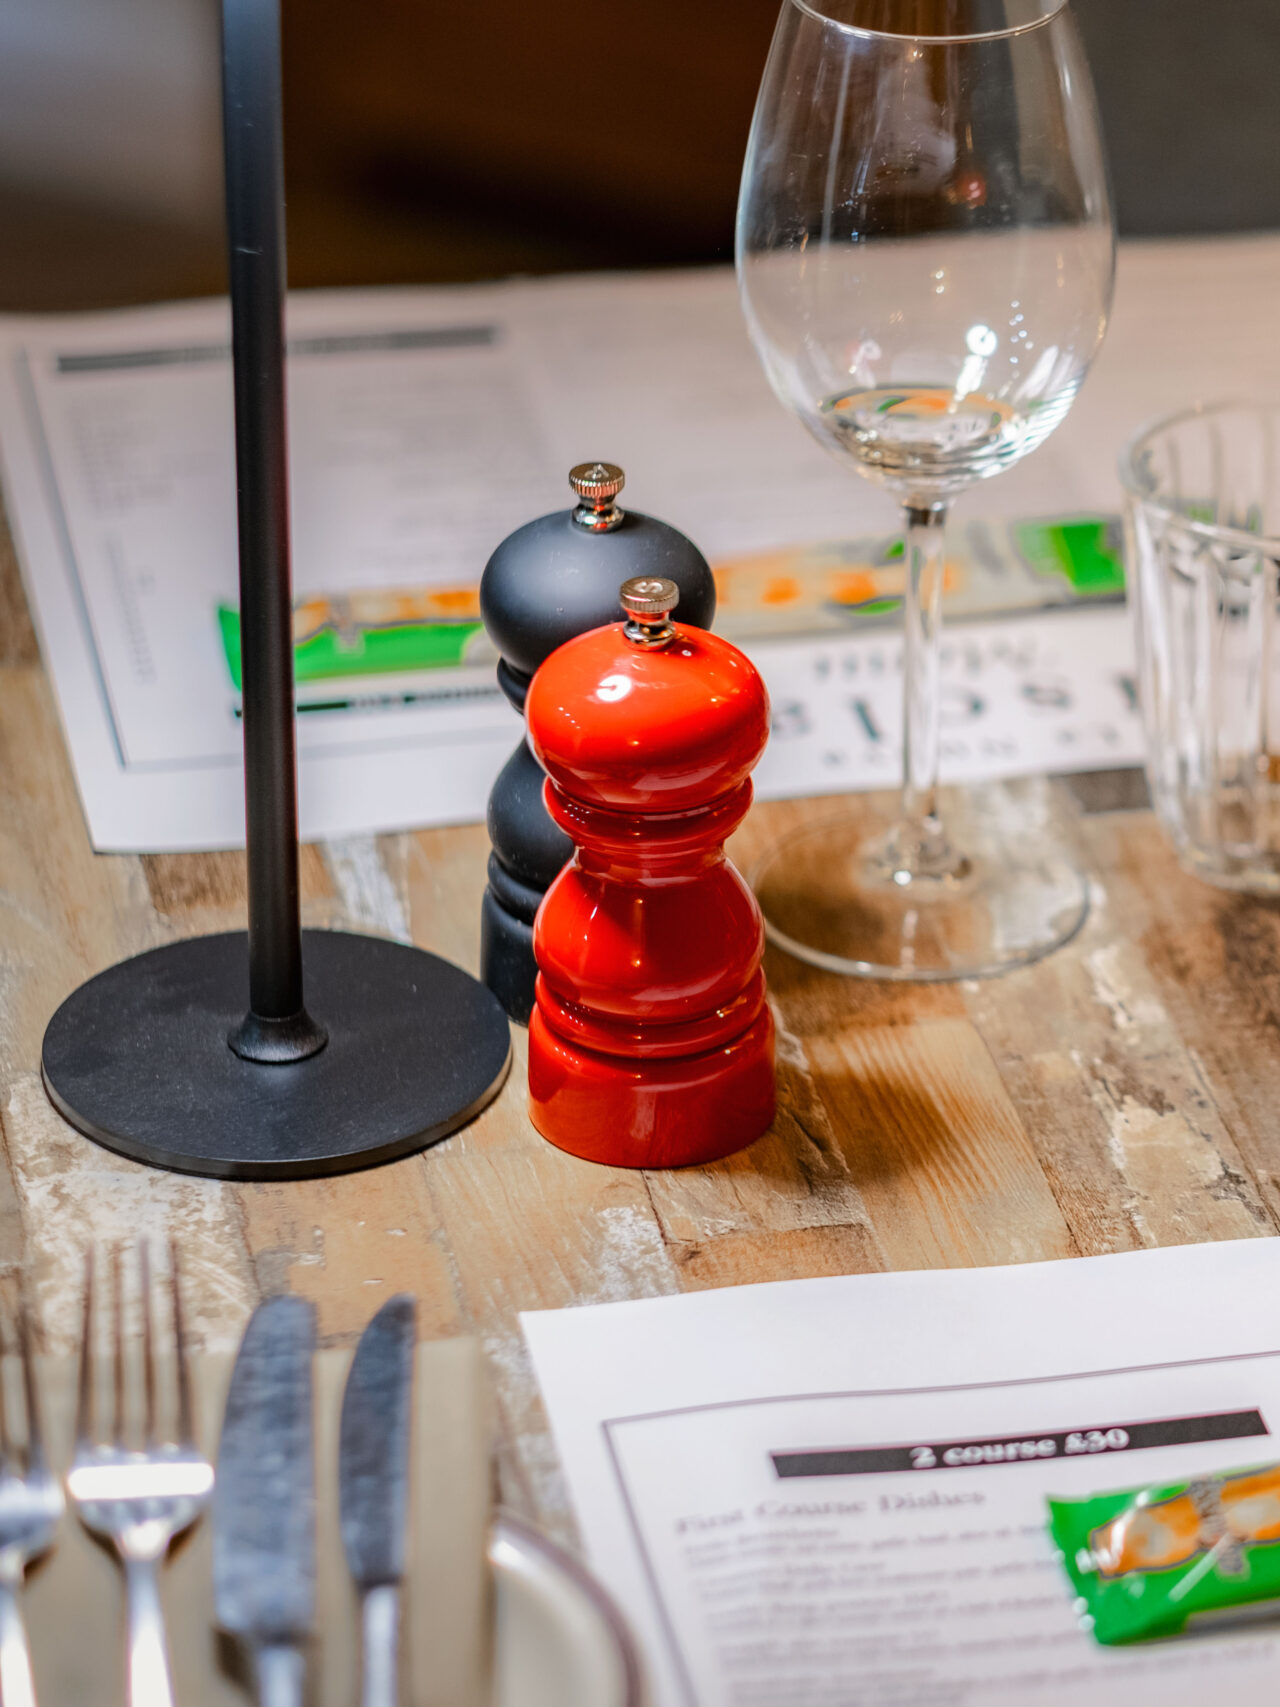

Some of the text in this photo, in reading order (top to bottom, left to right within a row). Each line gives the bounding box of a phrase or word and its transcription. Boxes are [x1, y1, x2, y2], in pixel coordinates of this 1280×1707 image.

[909, 1427, 1130, 1469] 2 course £30
